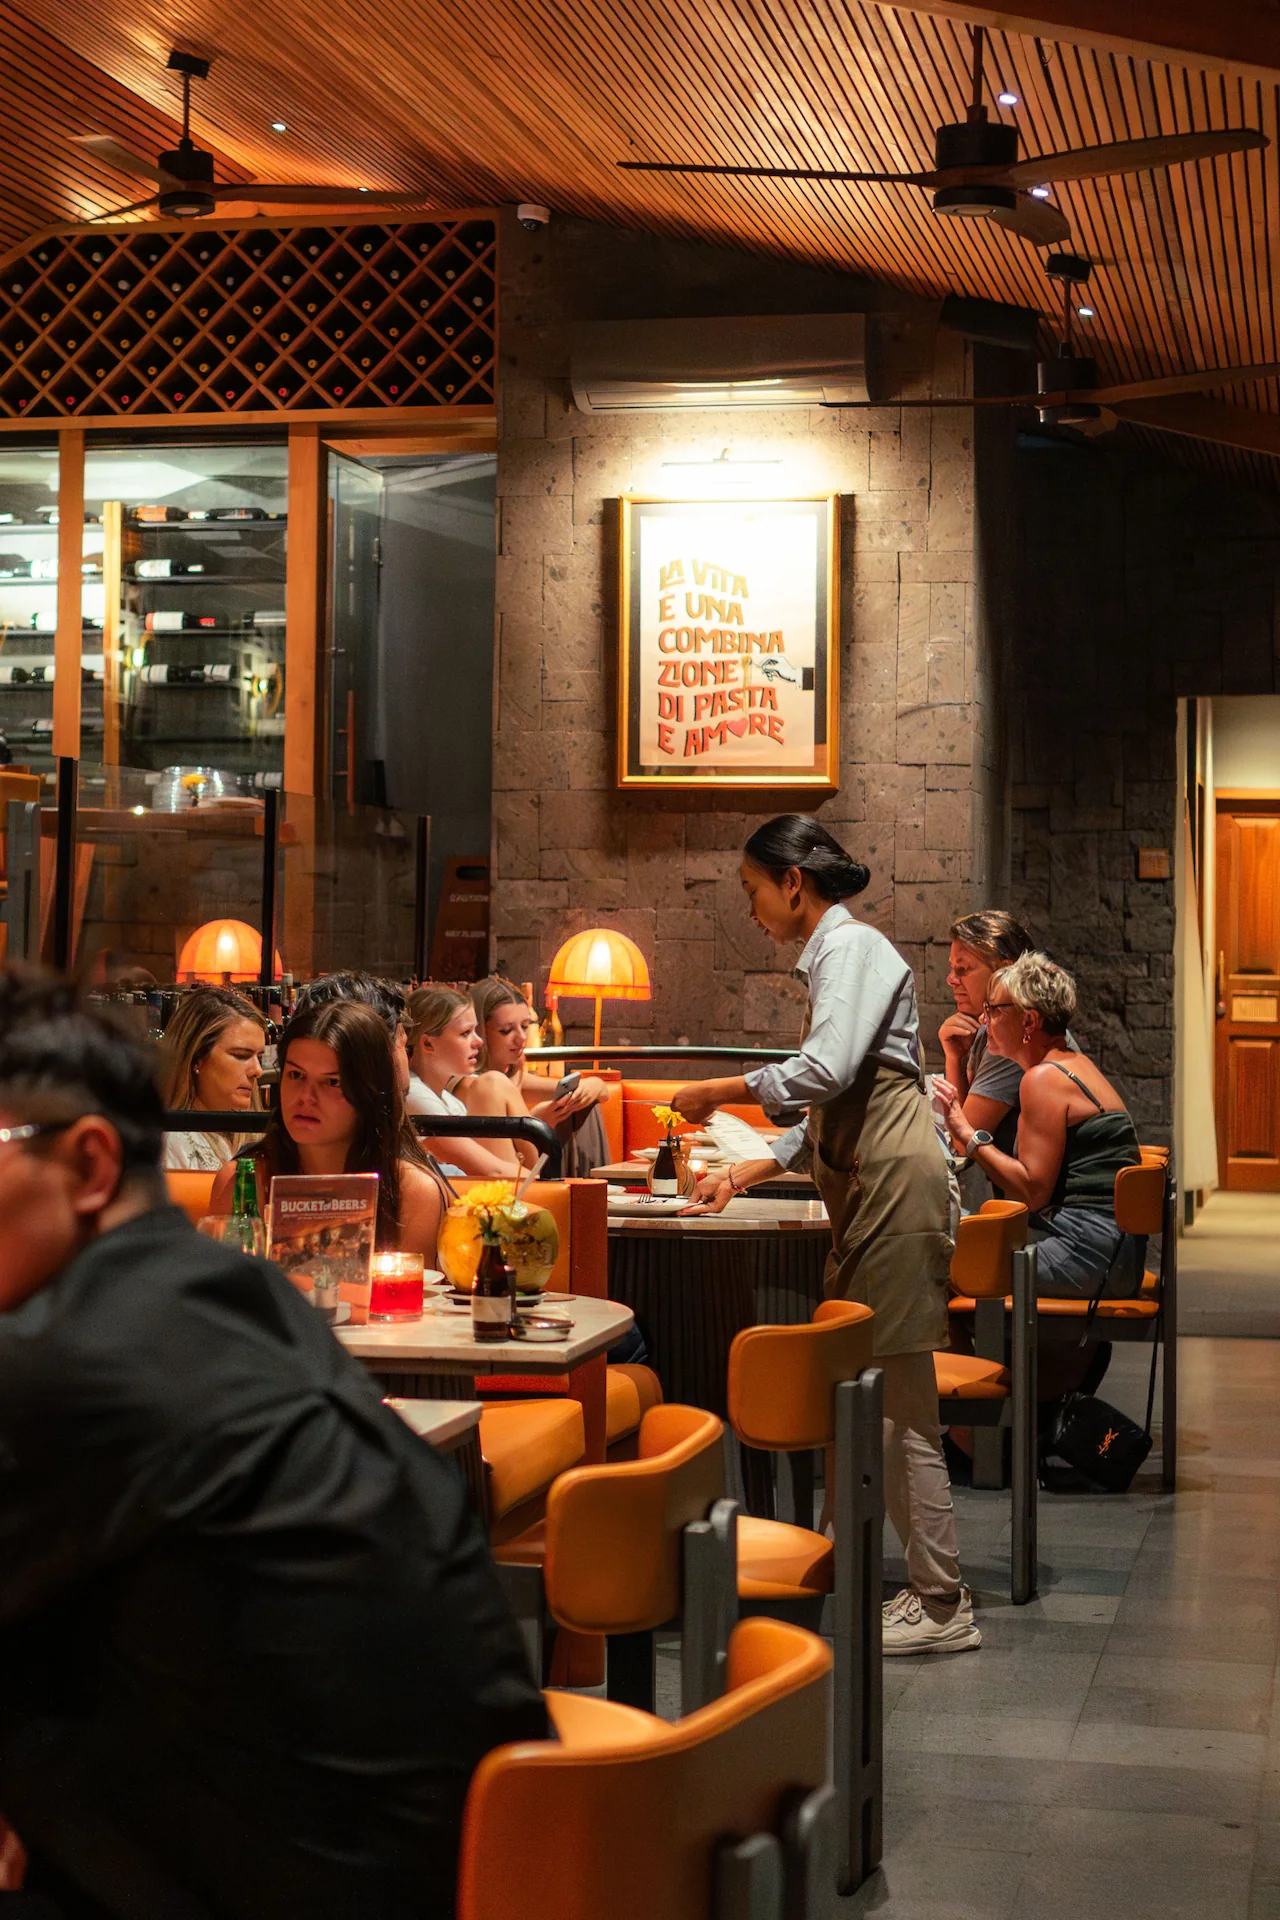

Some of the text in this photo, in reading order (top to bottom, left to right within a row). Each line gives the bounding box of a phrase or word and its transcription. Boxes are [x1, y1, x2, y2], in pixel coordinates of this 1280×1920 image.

[659, 558, 749, 599] LA VITA
[685, 592, 745, 626] UNA
[658, 627, 785, 654] COMBINA
[658, 660, 739, 688] ZIONE
[658, 686, 779, 723] DI PASTA
[657, 723, 676, 755] E
[280, 1200, 324, 1212] BUCKET
[331, 1199, 367, 1211] BEERS
